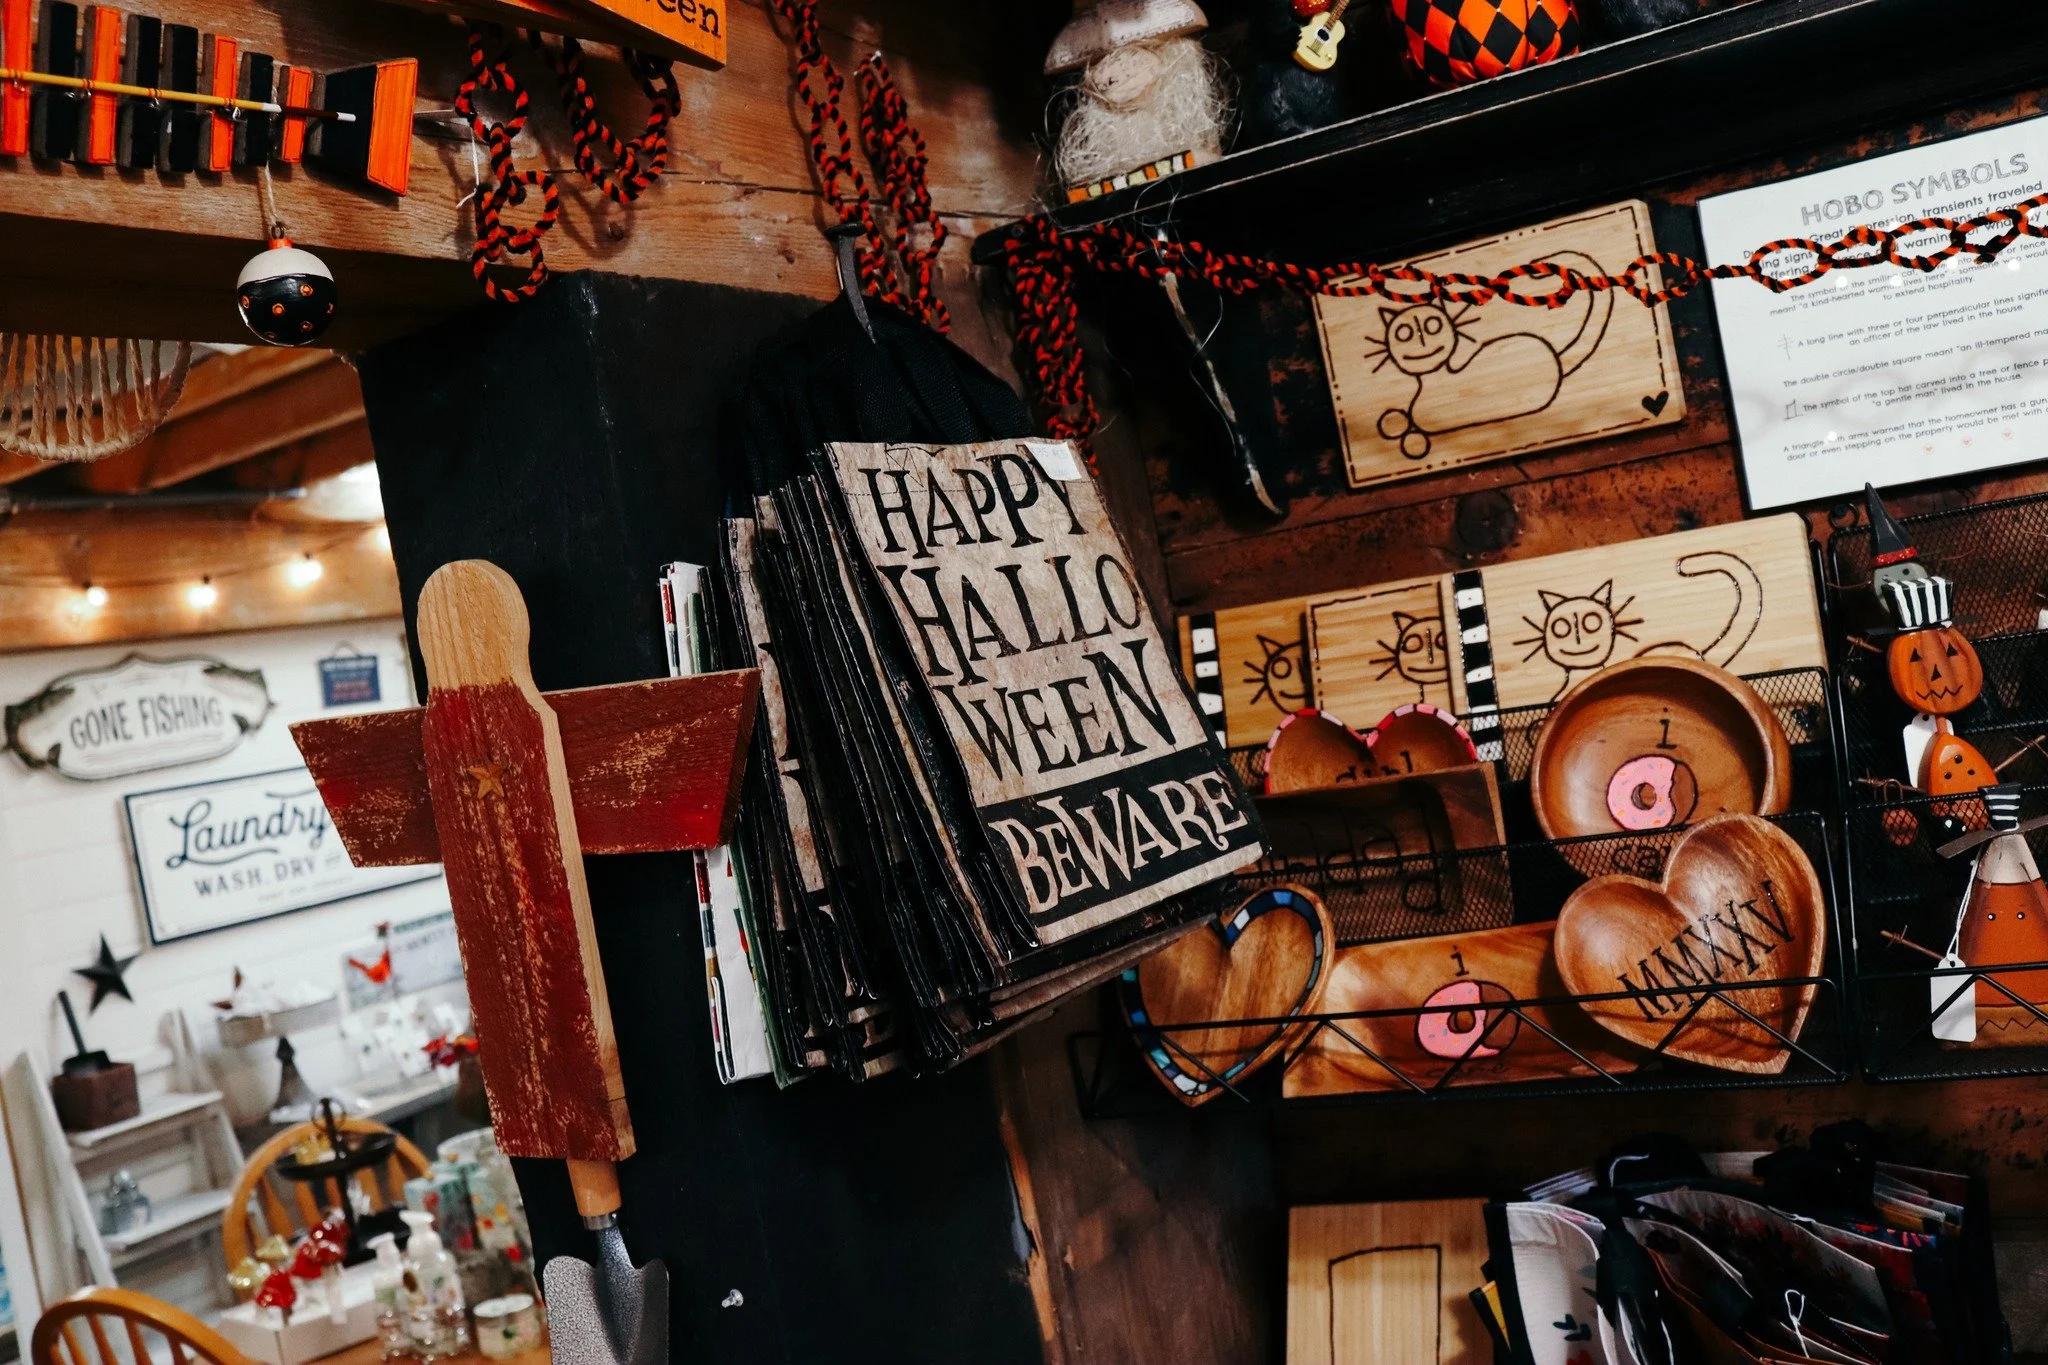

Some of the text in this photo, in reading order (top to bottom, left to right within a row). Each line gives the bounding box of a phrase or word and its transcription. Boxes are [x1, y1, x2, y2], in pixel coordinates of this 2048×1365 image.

[1801, 153, 2029, 226] HOBO SYMBOLS
[1810, 229, 1843, 243] Great
[1922, 196, 1983, 218] transients
[1988, 181, 2042, 202] traveled
[1785, 252, 1813, 265] signs
[1904, 233, 1950, 249] warnin
[2020, 241, 2045, 251] fence
[1770, 305, 1796, 316] meant
[1812, 292, 1864, 306] kind-hearted
[1904, 278, 1922, 287] lives
[2026, 250, 2048, 259] woul
[1791, 294, 1804, 302] The
[1808, 286, 1836, 298] symbol
[1851, 277, 1864, 287] the
[1896, 287, 1924, 297] extend
[1807, 336, 1825, 345] long
[1847, 328, 1864, 336] with
[1868, 323, 1890, 332] three
[1906, 316, 1922, 324] four
[1927, 302, 1990, 321] perpendicular
[1994, 296, 2014, 305] lines
[2018, 288, 2048, 301] signifie
[1864, 332, 1891, 343] officer
[1907, 325, 1920, 333] the
[1924, 322, 1939, 330] law
[1943, 316, 1964, 326] lived
[1979, 310, 1993, 318] the
[1801, 374, 1829, 384] double
[1832, 361, 1889, 378] circle/double
[1892, 355, 1922, 365] square
[1926, 348, 1953, 358] meant
[1975, 332, 2030, 348] ill-tempered
[1804, 404, 1817, 412] The
[1821, 397, 1849, 408] symbol
[1864, 392, 1877, 400] the
[1881, 389, 1895, 397] top
[1899, 384, 1912, 392] hat
[1916, 378, 1946, 390] carved
[1950, 374, 1966, 383] into
[1979, 369, 1997, 377] tree
[2014, 360, 2039, 370] fence
[1885, 395, 1912, 406] gentle
[1942, 384, 1962, 394] lived
[1977, 378, 1991, 386] the
[1994, 373, 2023, 383] house.
[1787, 453, 1806, 461] door
[1822, 446, 1841, 454] even
[1845, 438, 1881, 451] stepping
[1899, 432, 1912, 440] the
[1916, 425, 1953, 438] property
[1956, 419, 1984, 429] would
[1987, 416, 1998, 424] be
[2002, 412, 2019, 420] met
[2023, 407, 2042, 416] with
[1792, 440, 1824, 451] triangle
[1848, 432, 1869, 440] arms
[1872, 424, 1905, 435] warned
[1908, 420, 1925, 428] that
[1928, 416, 1942, 424] the
[1946, 406, 1998, 422] homeowner
[2002, 403, 2016, 411] has
[2030, 398, 2048, 407] gun
[858, 444, 1088, 559] HAPPY
[876, 553, 1143, 687] HALLO
[69, 693, 225, 751] GONE FISHING
[932, 638, 1177, 783] WEEN
[166, 798, 331, 868] Laundry
[987, 769, 1249, 915] BEWARE
[274, 854, 319, 882] DRY
[1617, 880, 1795, 1022] MMXXV
